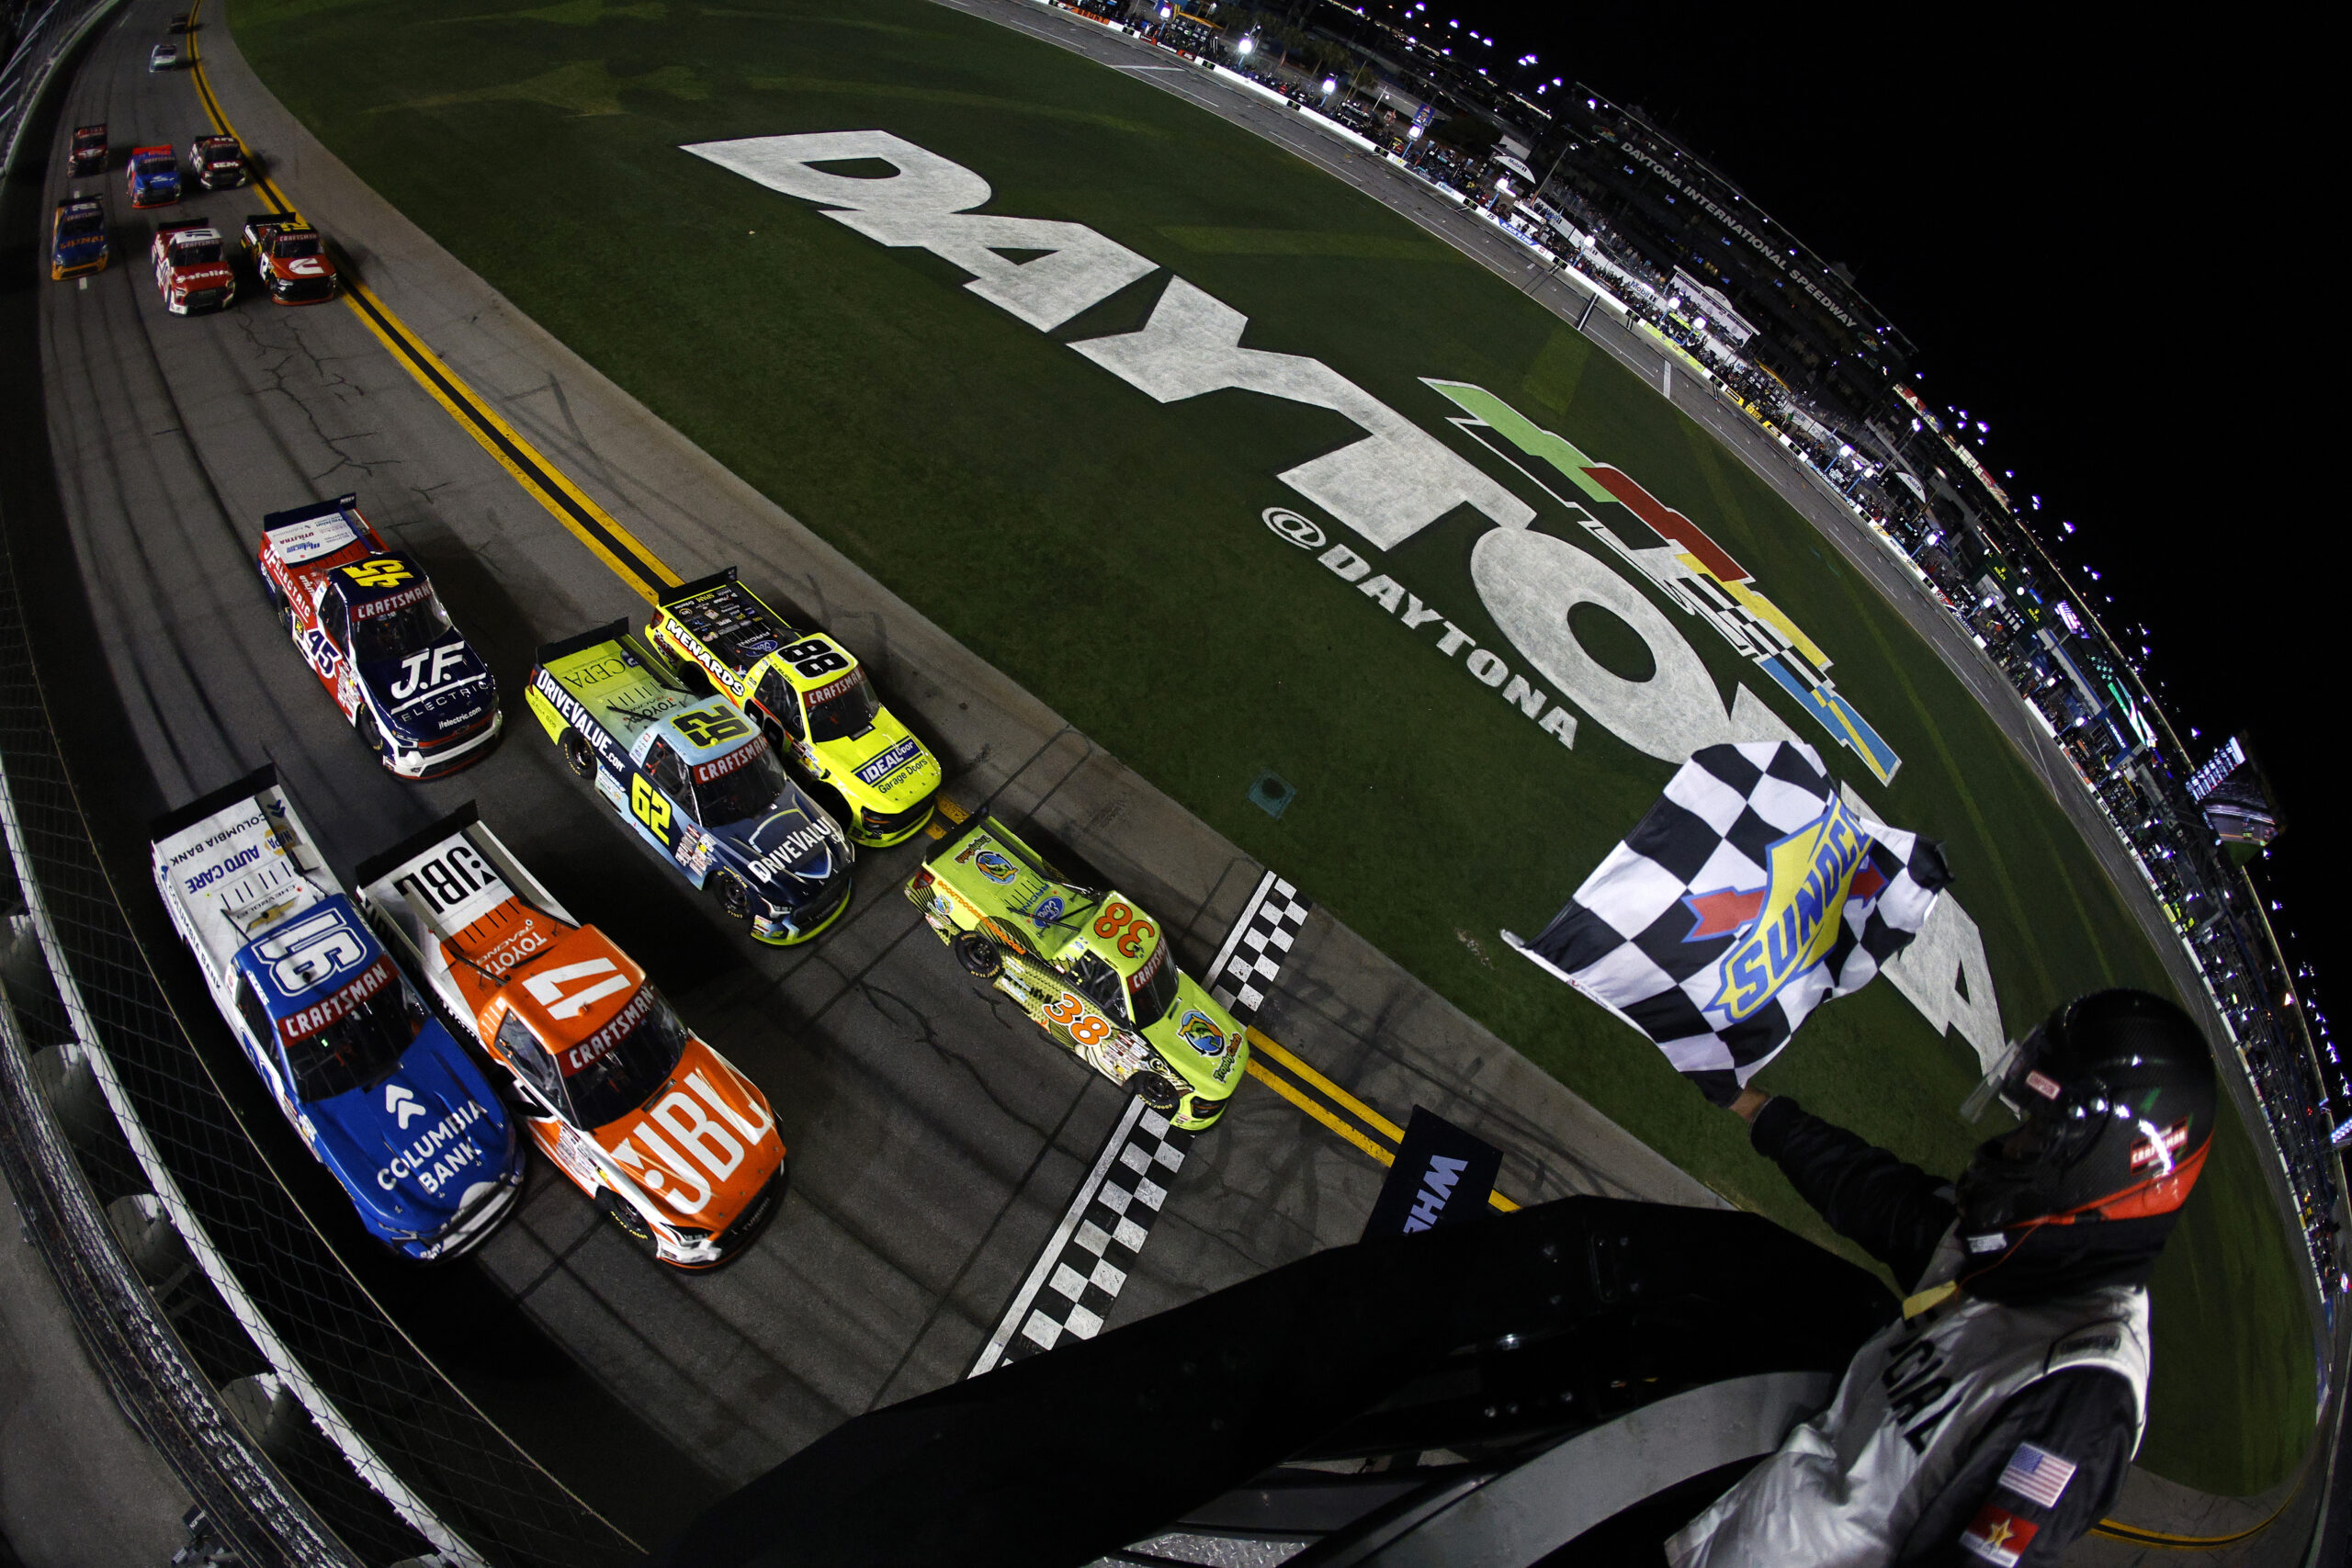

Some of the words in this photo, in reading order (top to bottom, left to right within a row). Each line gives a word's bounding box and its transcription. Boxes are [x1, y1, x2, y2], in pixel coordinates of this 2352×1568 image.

[1508, 157, 1522, 170] Mobil
[1621, 141, 1682, 188] DAYTONA
[1682, 185, 1787, 271] INTERNATIONAL
[1789, 269, 1858, 329] SPEEDWAY
[1630, 279, 1650, 298] Mobil
[276, 559, 311, 617] ELECTRIC
[341, 558, 413, 588] 45
[1935, 591, 1945, 601] 45
[1994, 566, 2007, 581] ROLEX
[357, 584, 432, 619] CRAFTSMAN
[695, 592, 715, 603] SPAM
[2028, 608, 2040, 623] ROLEX
[678, 129, 2021, 1119] DAYTOA
[1261, 506, 1581, 750] @DAYTONA
[306, 628, 342, 678] 45
[390, 640, 465, 700] J.F.
[563, 658, 627, 689] CEPA
[665, 618, 745, 697] MENARDS
[776, 638, 851, 680] 88
[401, 681, 489, 723] ELECTRIC
[808, 668, 864, 705] CRAFTSMAN
[438, 705, 482, 731] jfelectric.com
[670, 704, 752, 750] 62
[699, 737, 768, 782] CRAFTSMAN
[862, 751, 905, 784] IDEAL
[896, 740, 914, 755] Door
[877, 772, 908, 794] Garage
[906, 758, 928, 775] Doors
[206, 813, 266, 848] COLUMBIA
[631, 772, 672, 846] 62
[169, 840, 205, 867] BANK
[223, 844, 261, 874] AUTO
[747, 816, 832, 884] DRIVEVALU
[954, 833, 992, 865] TrophyCatch
[184, 863, 225, 896] CARE
[392, 845, 482, 915] JBL
[168, 885, 201, 954] COLUMBIA
[200, 953, 221, 990] BANK
[251, 908, 368, 998] 91
[1092, 901, 1156, 960] 38
[285, 962, 389, 1038] CRAFTSMAN
[521, 956, 633, 1021] 17
[568, 984, 654, 1069] CRAFTSMAN
[1042, 991, 1113, 1046] 38
[1212, 1032, 1243, 1084] TrophyCatch
[377, 1100, 489, 1191] COLUMBIA
[418, 1136, 483, 1194] BANK
[632, 1071, 775, 1215] JBL
[2132, 1129, 2186, 1165] CRAFMAN
[1881, 1308, 1962, 1456] ICIAL
